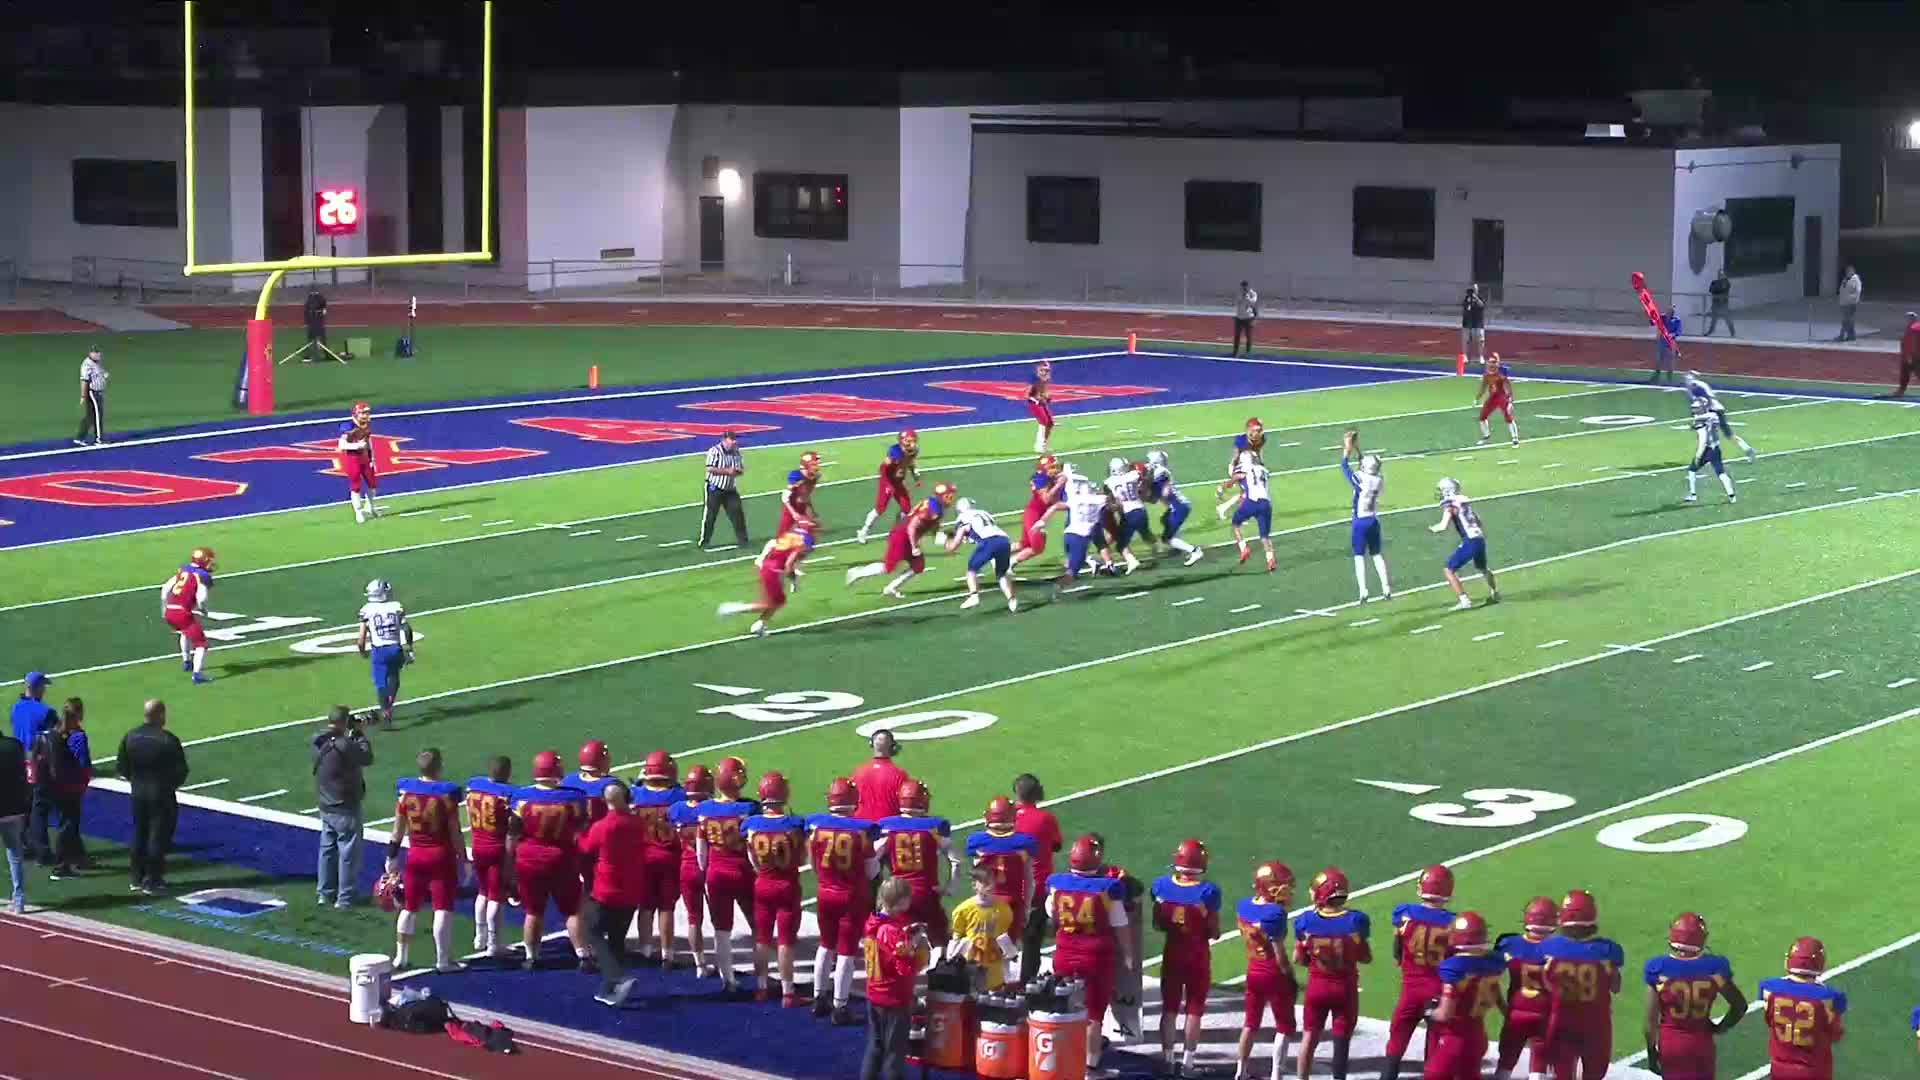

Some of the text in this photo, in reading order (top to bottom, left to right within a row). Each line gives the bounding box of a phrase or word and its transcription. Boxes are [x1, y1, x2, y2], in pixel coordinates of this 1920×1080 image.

[320, 191, 356, 225] 26
[0, 383, 1169, 526] OXANA
[696, 690, 999, 741] 20
[1408, 788, 1749, 853] 30
[816, 831, 852, 870] 79
[1058, 895, 1096, 934] 64
[1037, 1032, 1053, 1053] G
[1773, 997, 1816, 1046] 52
